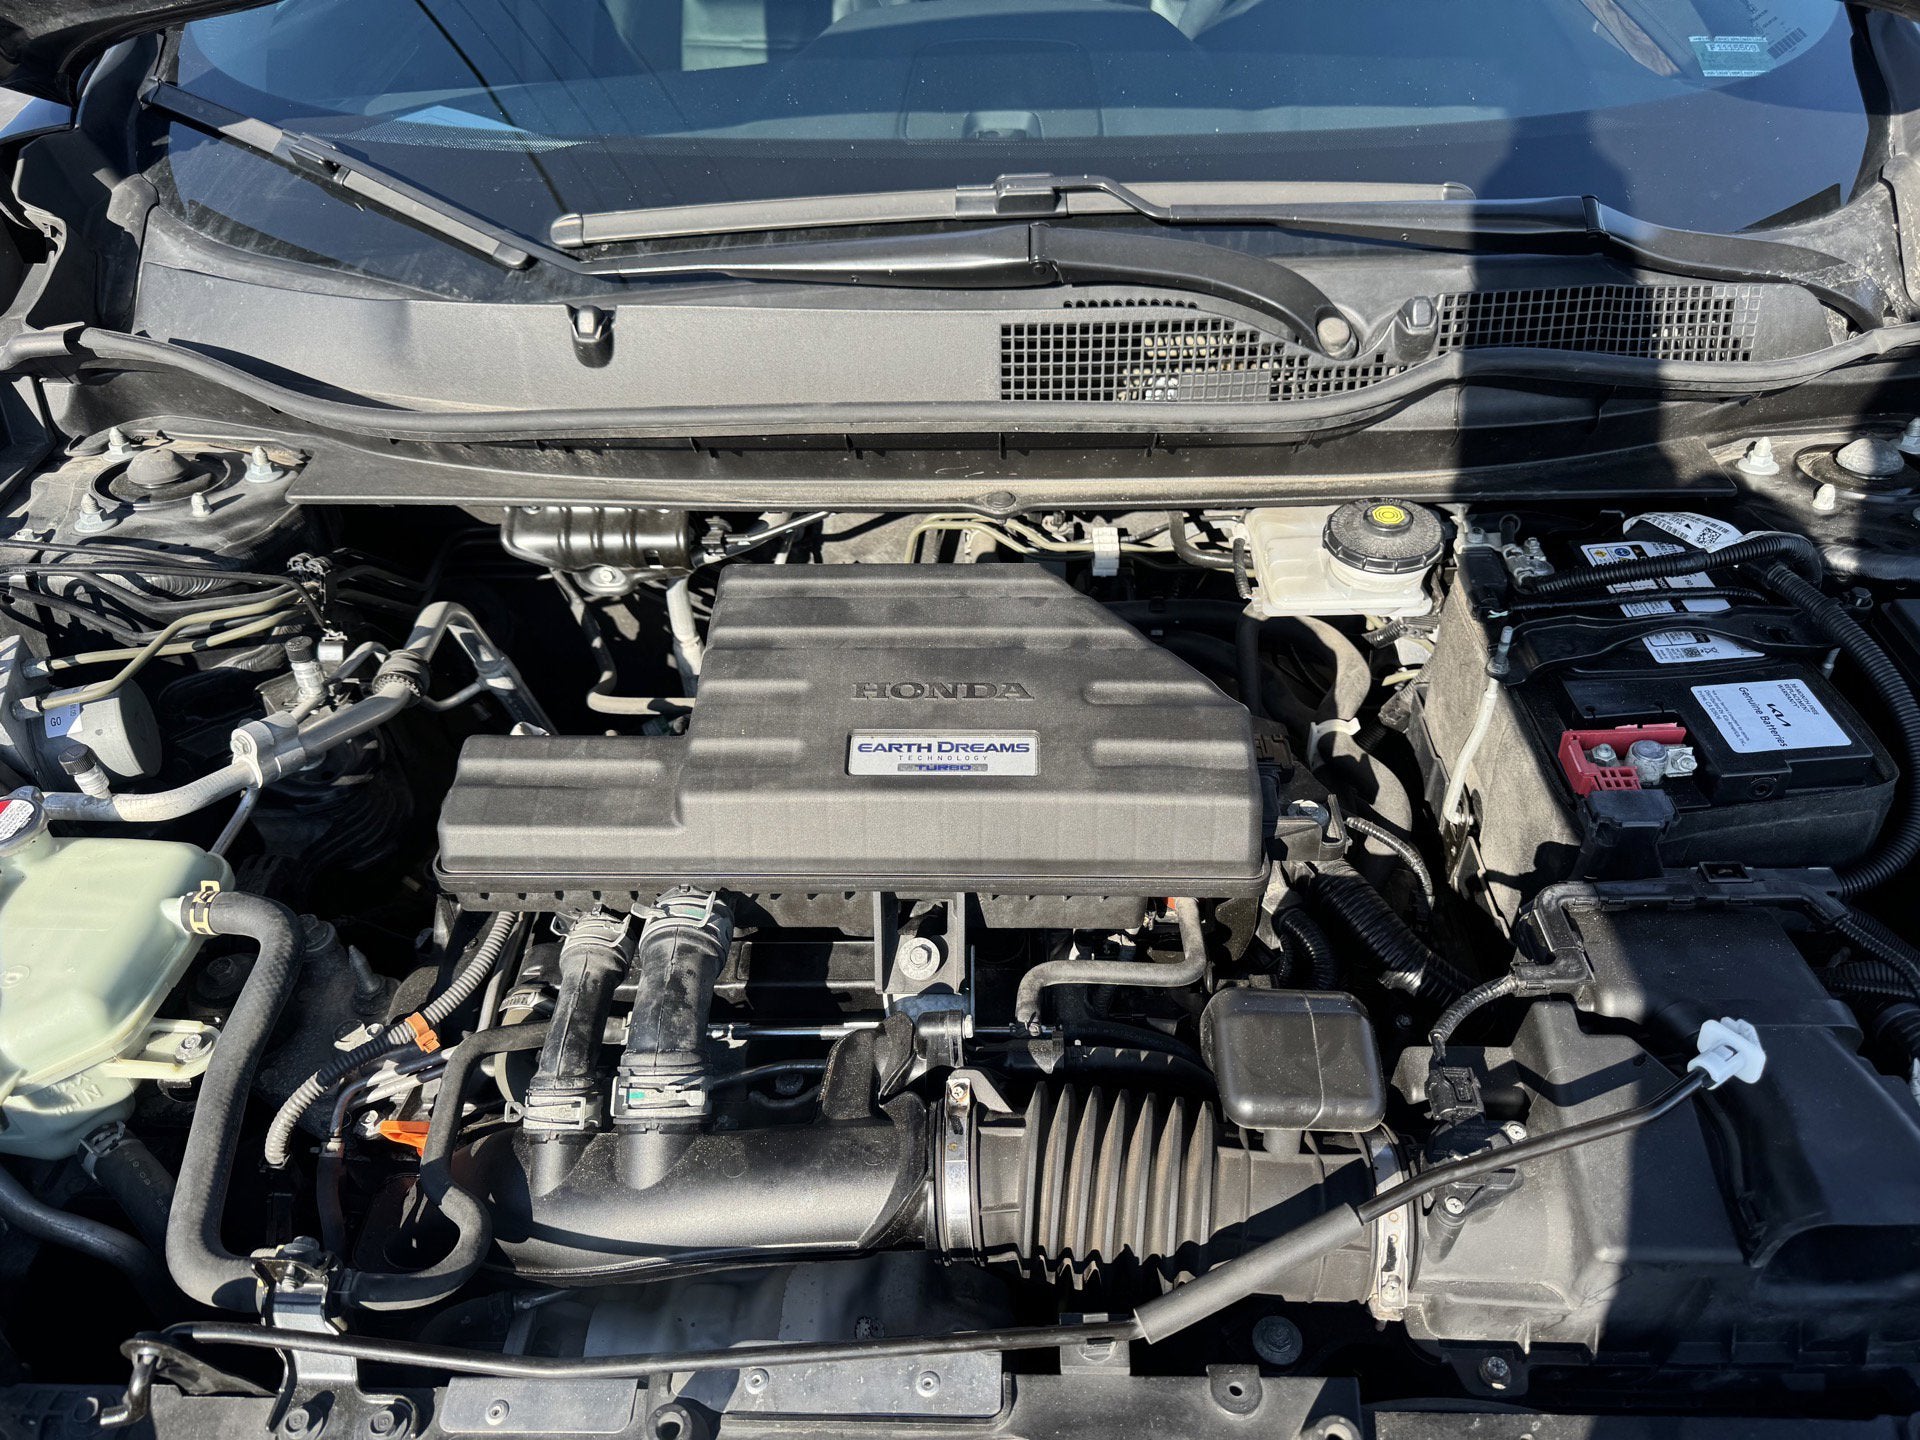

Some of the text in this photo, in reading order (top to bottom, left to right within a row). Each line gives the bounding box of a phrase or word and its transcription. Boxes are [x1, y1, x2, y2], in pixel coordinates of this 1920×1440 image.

[852, 681, 1035, 701] HONDA
[1738, 686, 1788, 747] Genuine Batteries
[858, 741, 1030, 753] EARTH DREAMS
